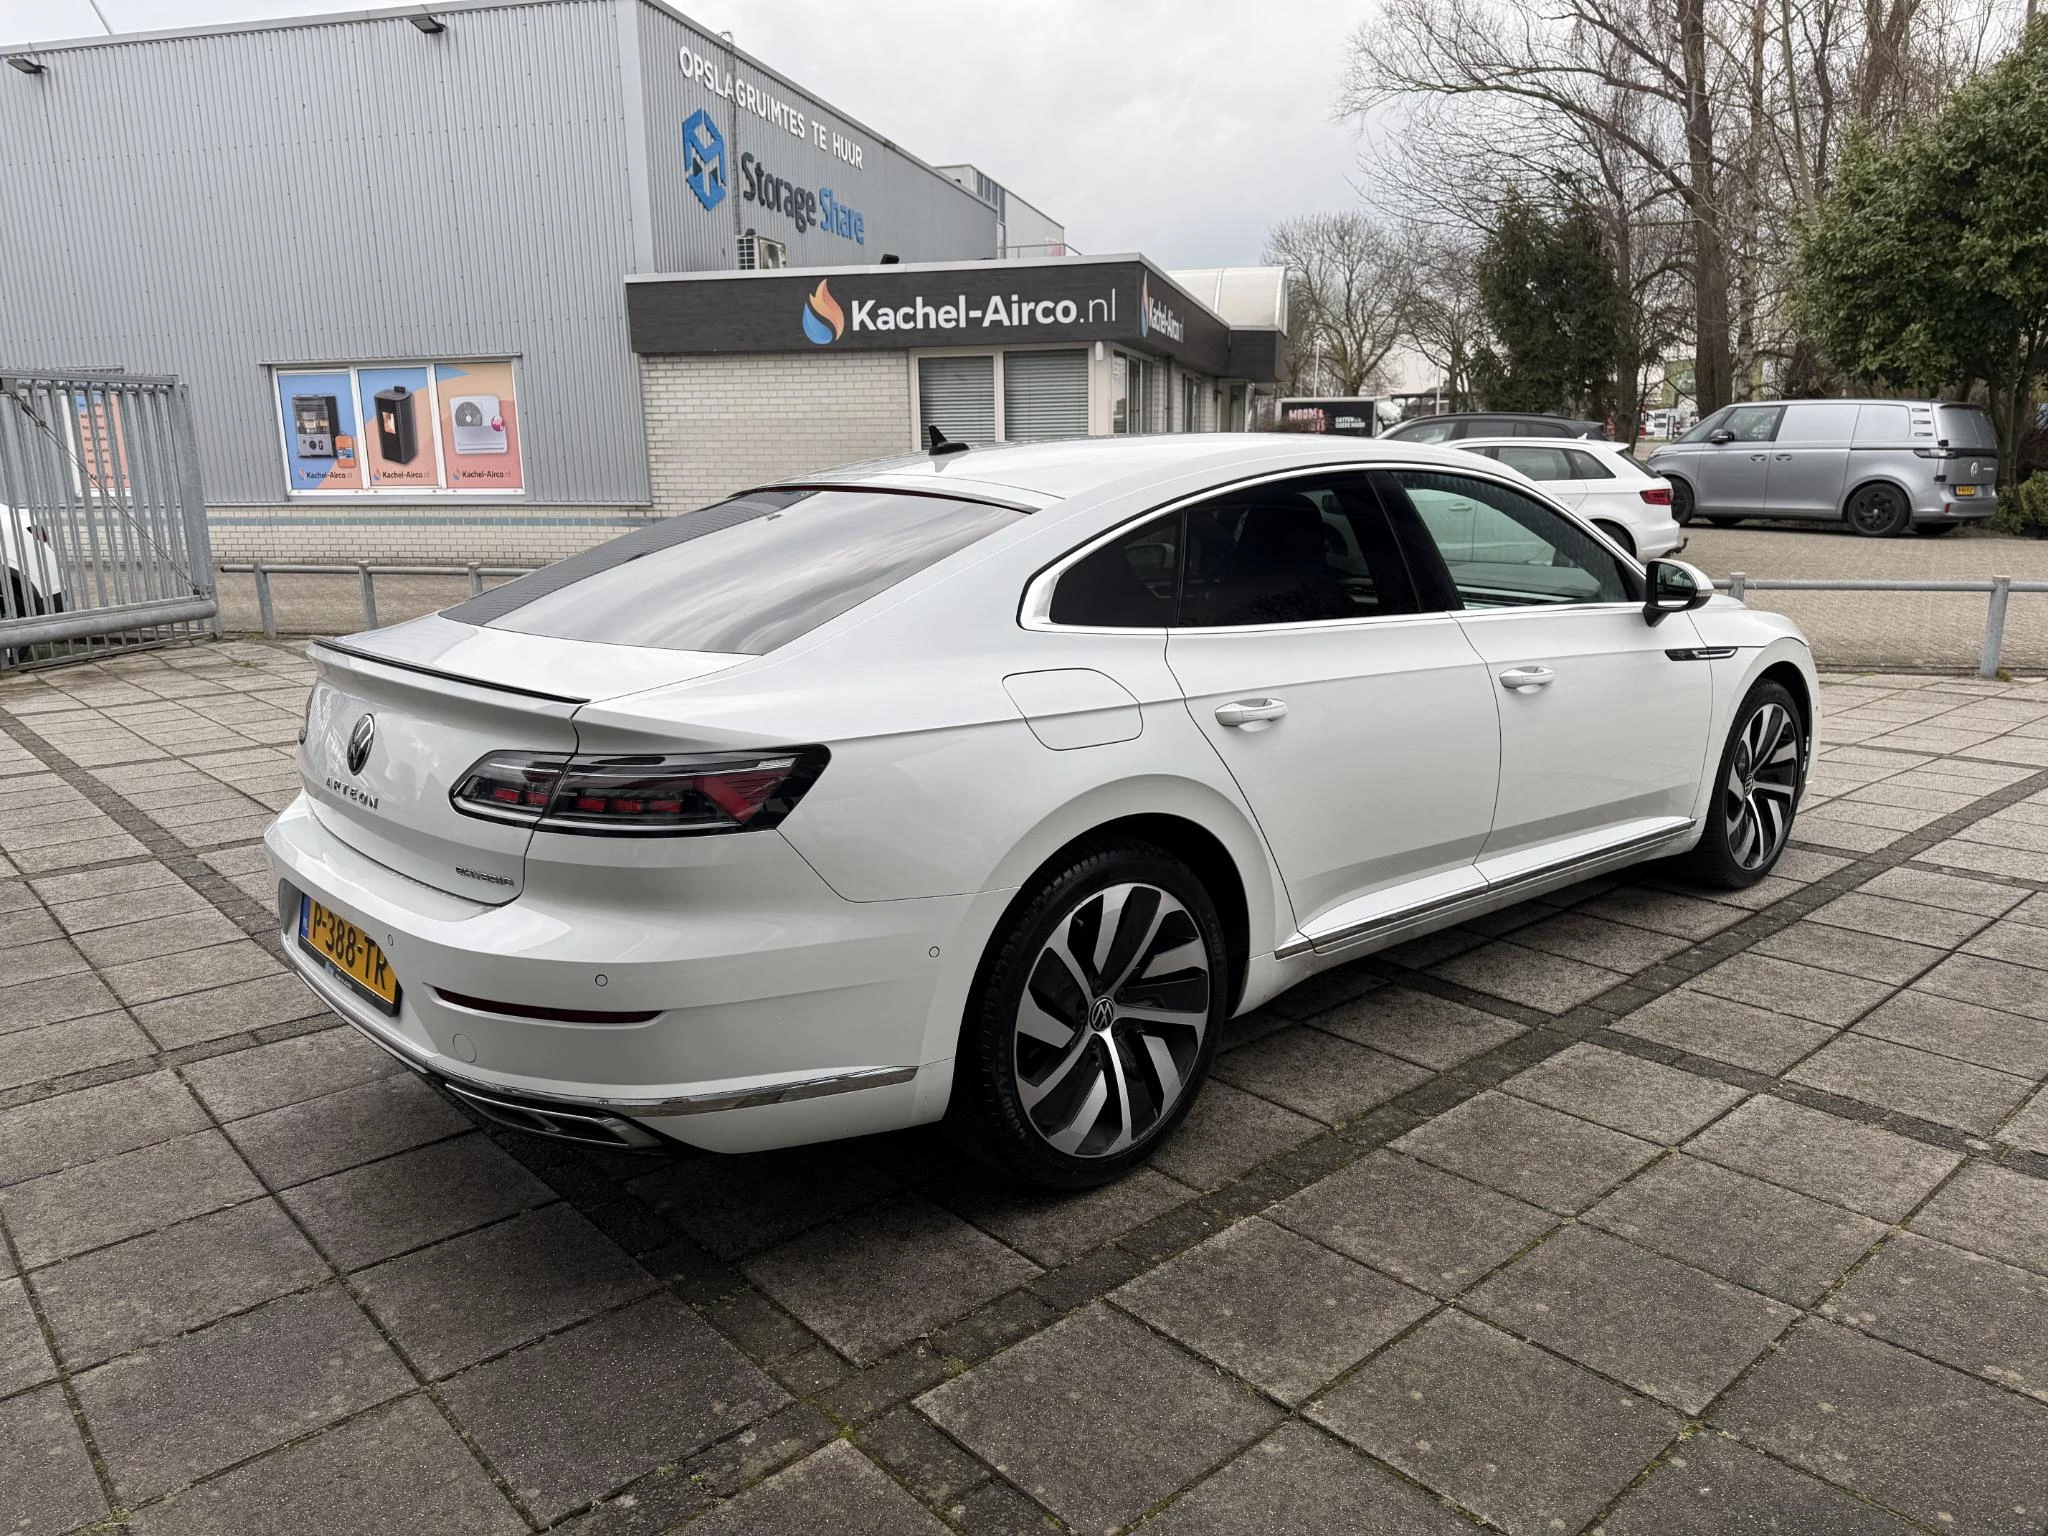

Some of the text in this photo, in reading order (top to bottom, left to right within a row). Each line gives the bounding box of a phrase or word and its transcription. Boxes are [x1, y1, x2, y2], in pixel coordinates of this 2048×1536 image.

[679, 46, 863, 170] OPSLAGRUIMTES TE HUUR
[741, 152, 865, 245] Storage Share
[851, 288, 1116, 332] Kachel-Airco.nl
[326, 776, 379, 809] ARTEON
[312, 901, 386, 991] P-388-TR
